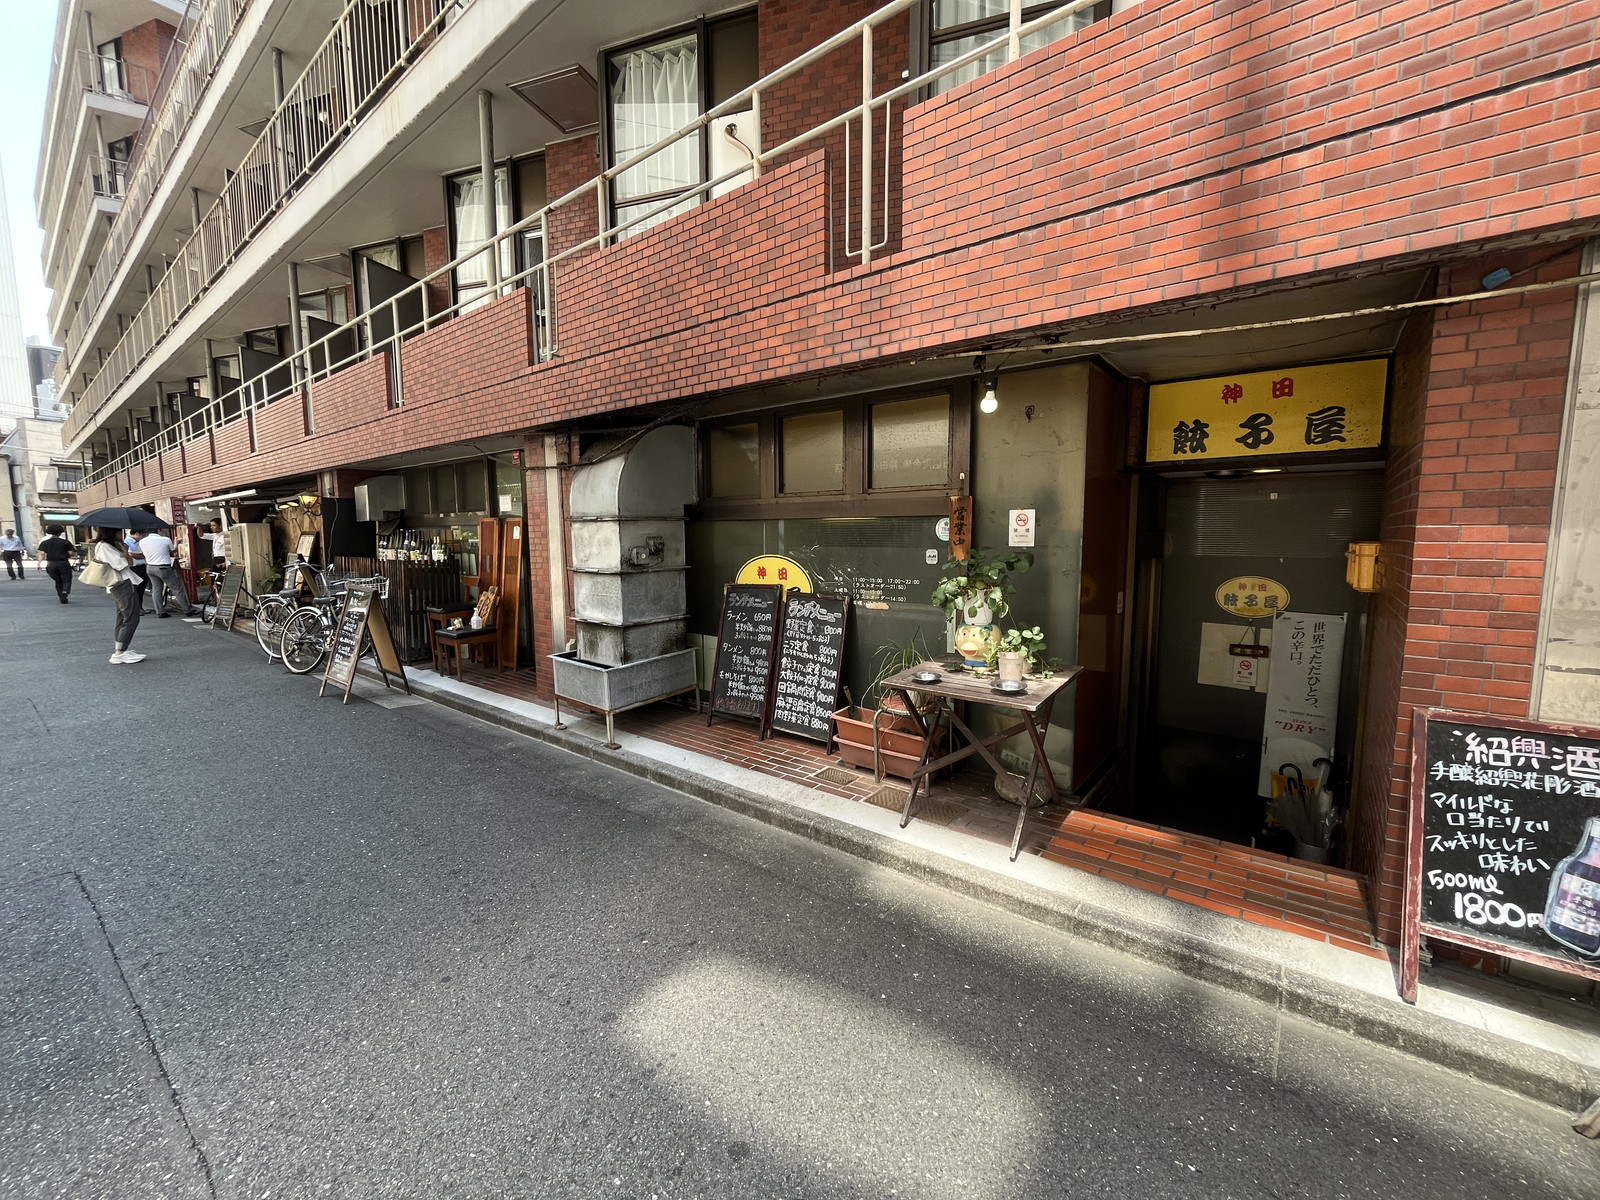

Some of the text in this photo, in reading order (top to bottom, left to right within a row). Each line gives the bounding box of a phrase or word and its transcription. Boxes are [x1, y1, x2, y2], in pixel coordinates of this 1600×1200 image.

[1221, 377, 1294, 404] 神田
[1172, 405, 1347, 455] 餃子屋
[757, 566, 788, 580] 神田
[729, 593, 774, 609] ランチメニュー
[788, 598, 842, 623] ランチメニュー
[727, 610, 772, 622] ラーメン 650円
[824, 625, 842, 635] 800円
[723, 642, 743, 654] タンメン
[783, 639, 838, 657] ニラ定食 800円
[1465, 731, 1600, 780] 紹興酒
[1430, 792, 1514, 814] マイルドな
[1426, 831, 1538, 852] スッキリとした
[1478, 852, 1551, 876] 味わい
